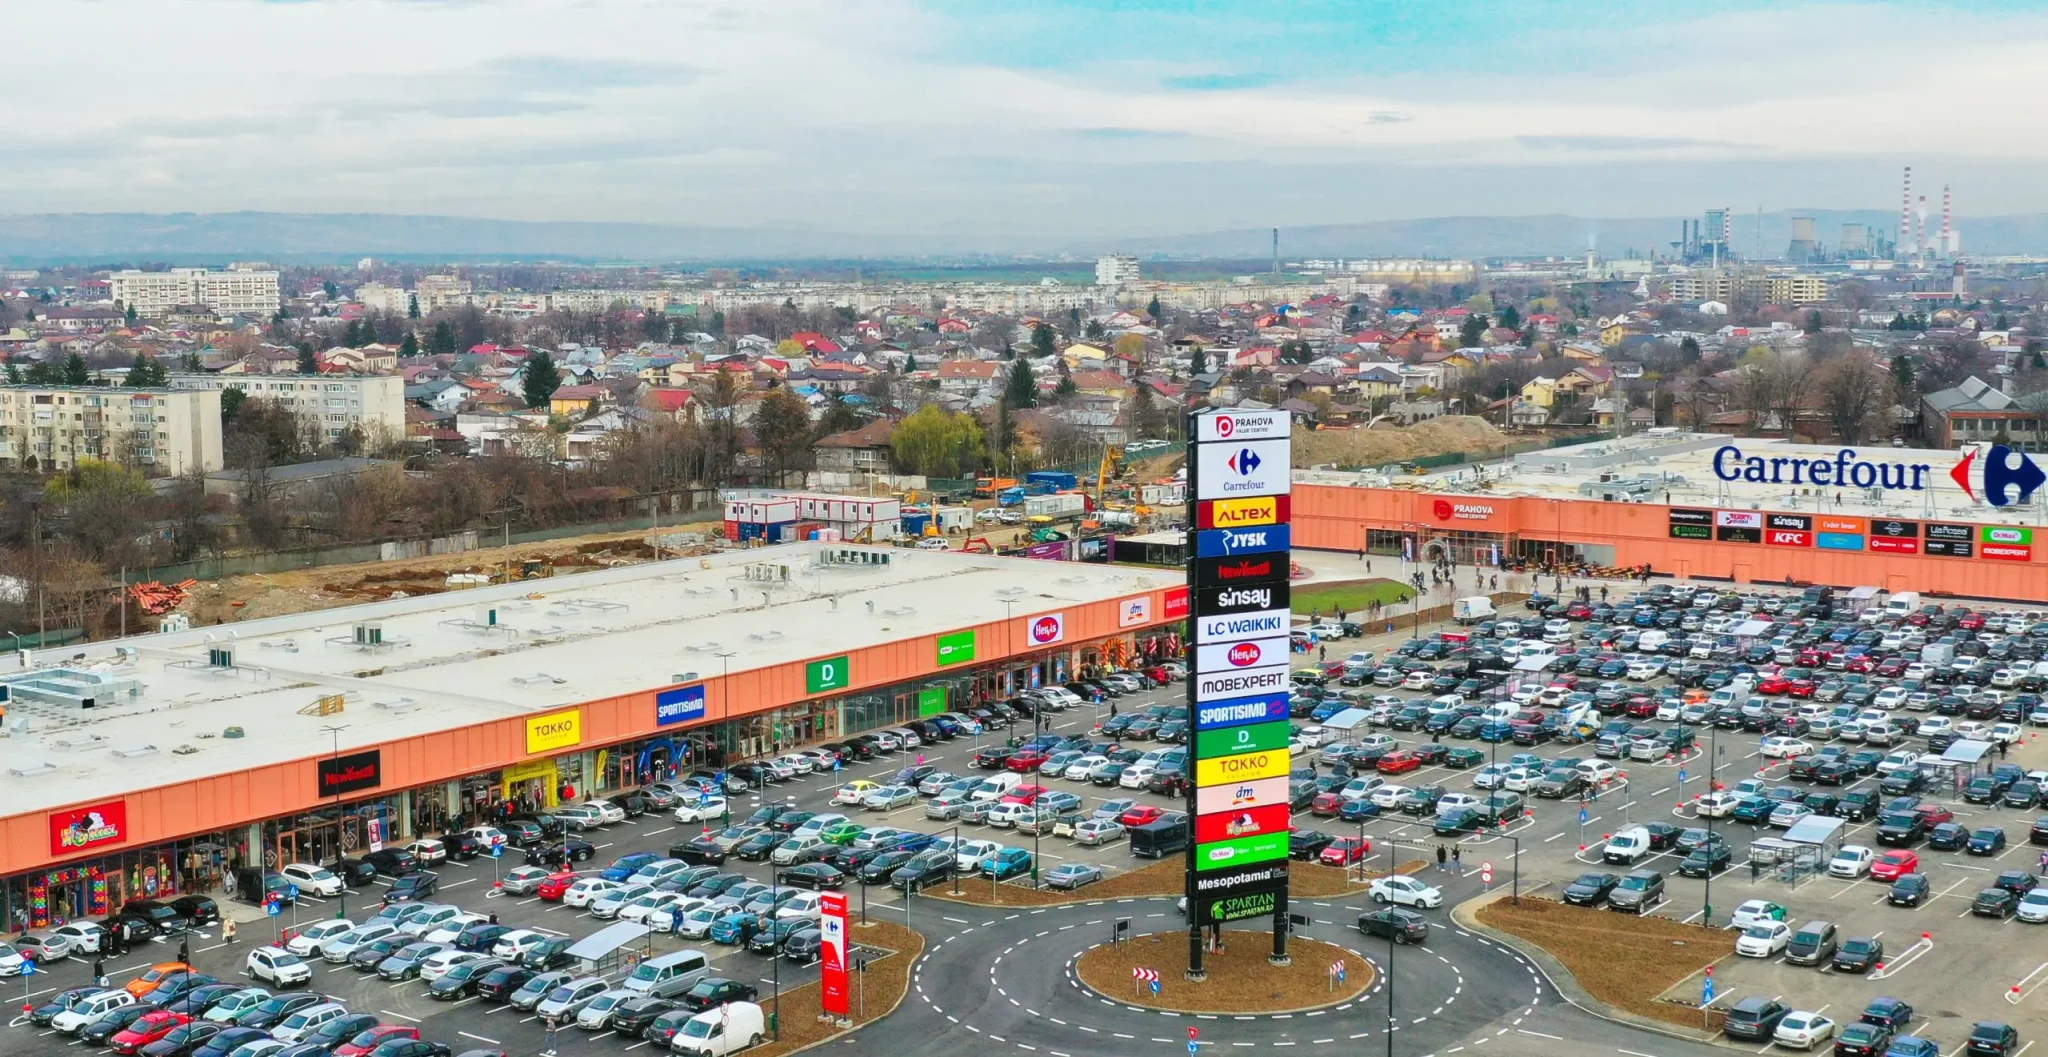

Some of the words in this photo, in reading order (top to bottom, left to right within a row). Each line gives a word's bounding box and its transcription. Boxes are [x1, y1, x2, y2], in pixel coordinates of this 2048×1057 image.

[1236, 417, 1273, 427] PRAHOVA
[1713, 445, 1930, 490] Carrefour
[1223, 480, 1265, 491] Carrefour
[1454, 504, 1493, 514] PRAHOVA
[1773, 516, 1804, 529] sinsay
[1231, 532, 1267, 548] JYSK
[1773, 532, 1803, 544] KFC
[1218, 587, 1271, 608] sinsay
[1130, 603, 1142, 614] dm
[1035, 622, 1057, 637] Hervis
[1208, 622, 1225, 636] LC
[1231, 648, 1258, 661] Hervis
[822, 664, 834, 681] D
[1202, 672, 1284, 694] MOBEXPERT
[658, 698, 703, 718] SPORTISIMO
[1200, 702, 1267, 725] SPORTISIMO
[534, 720, 572, 737] TAKKO
[1238, 730, 1249, 743] D
[1219, 755, 1268, 773] TAKKO
[1236, 786, 1253, 798] dm
[1211, 848, 1231, 858] Dr.Max
[1198, 869, 1271, 890] Mesopotamia
[1226, 892, 1275, 912] SPARTAN
